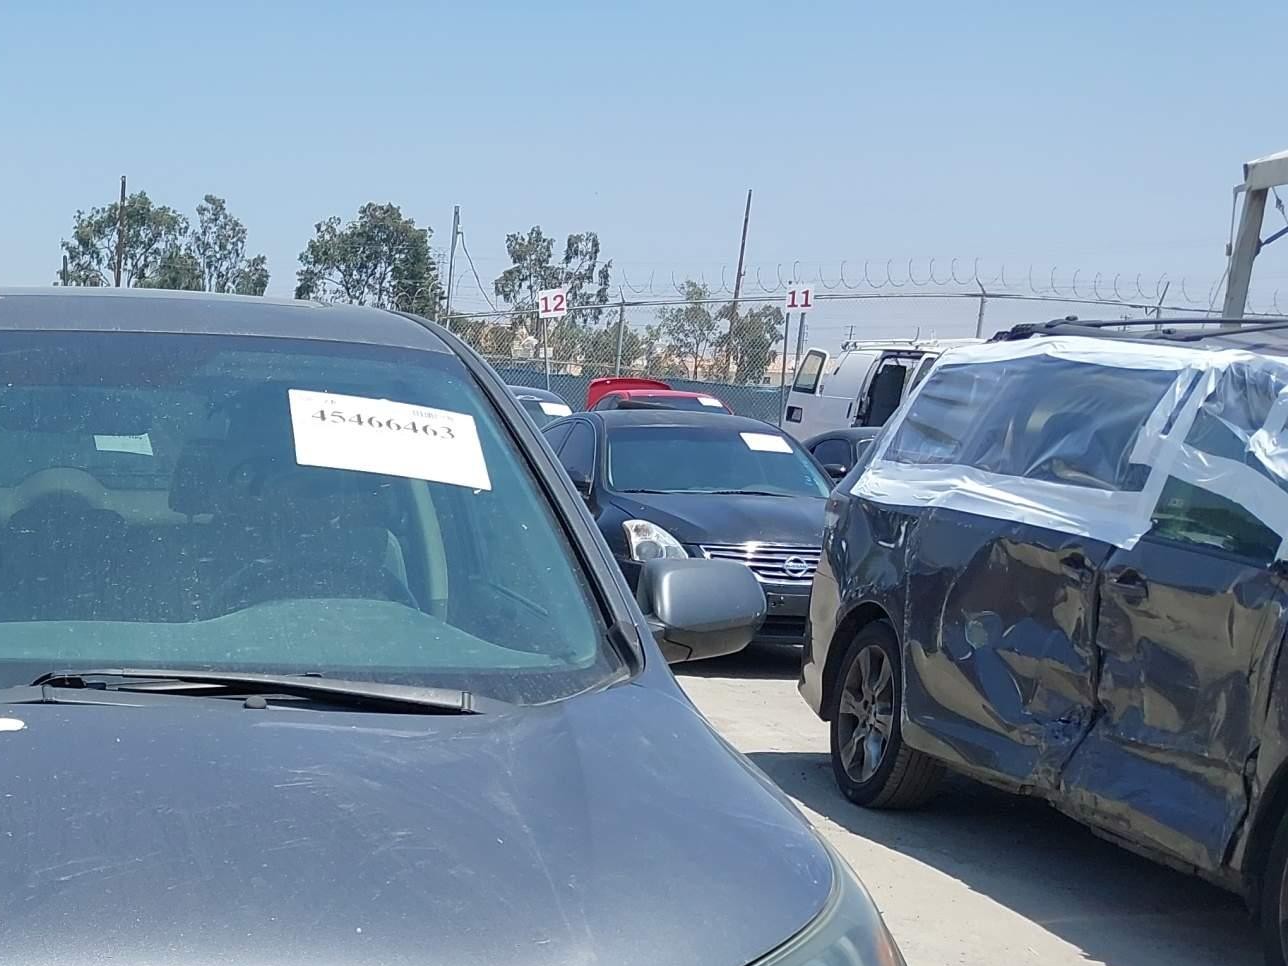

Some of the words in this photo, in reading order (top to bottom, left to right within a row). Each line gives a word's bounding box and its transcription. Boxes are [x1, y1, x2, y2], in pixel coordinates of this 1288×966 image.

[541, 295, 565, 313] 12
[787, 290, 811, 307] 11
[312, 409, 456, 440] 45466463
